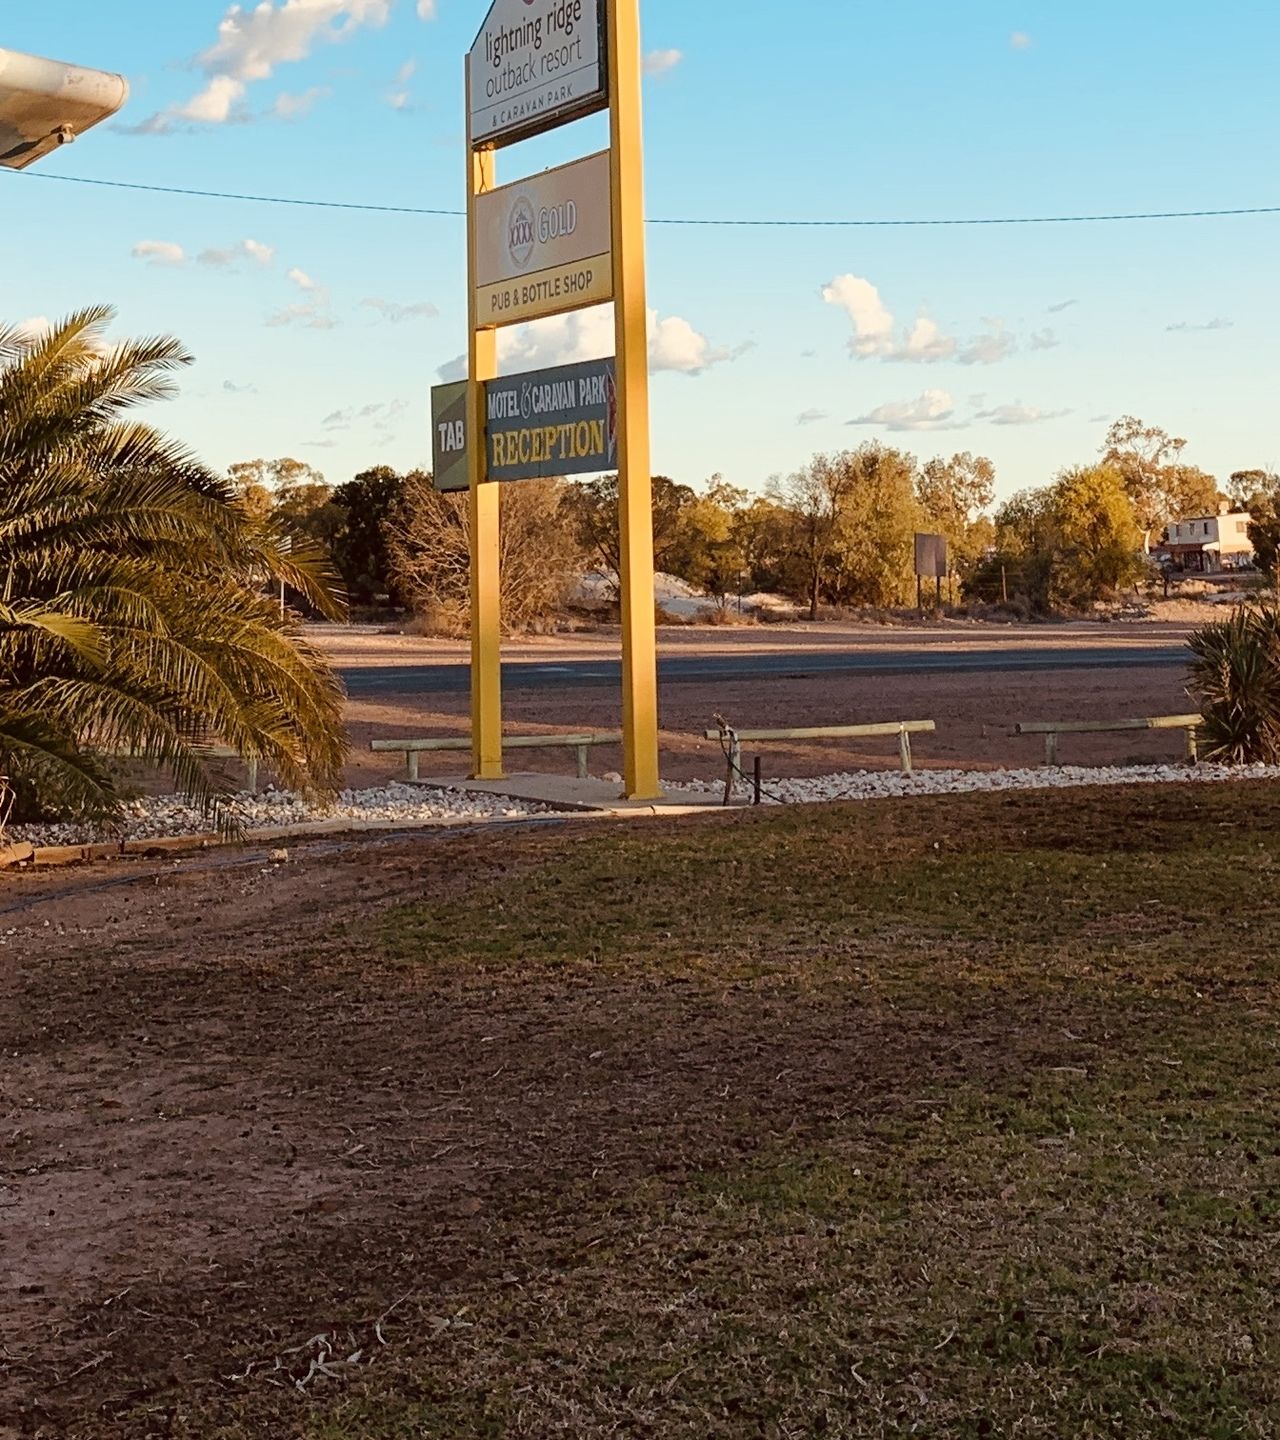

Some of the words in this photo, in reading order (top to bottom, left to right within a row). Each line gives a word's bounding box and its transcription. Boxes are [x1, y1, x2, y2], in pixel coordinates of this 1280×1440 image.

[485, 16, 542, 68] lightning
[486, 52, 537, 98] outback
[541, 35, 582, 75] resort
[491, 115, 498, 127] &
[500, 96, 545, 123] CARAVAN
[548, 83, 574, 103] PARK
[509, 220, 534, 249] XXXX
[538, 200, 577, 244] GOLD
[491, 292, 511, 312] PUB
[512, 289, 520, 305] &
[522, 278, 561, 305] BOTTLE
[563, 270, 593, 293] SHOP
[487, 389, 520, 420] MOTEL
[520, 382, 532, 419] &
[532, 380, 576, 414] CARAVAN
[579, 374, 607, 406] PARK
[439, 420, 465, 453] TAB
[491, 419, 606, 467] RECEPTION
